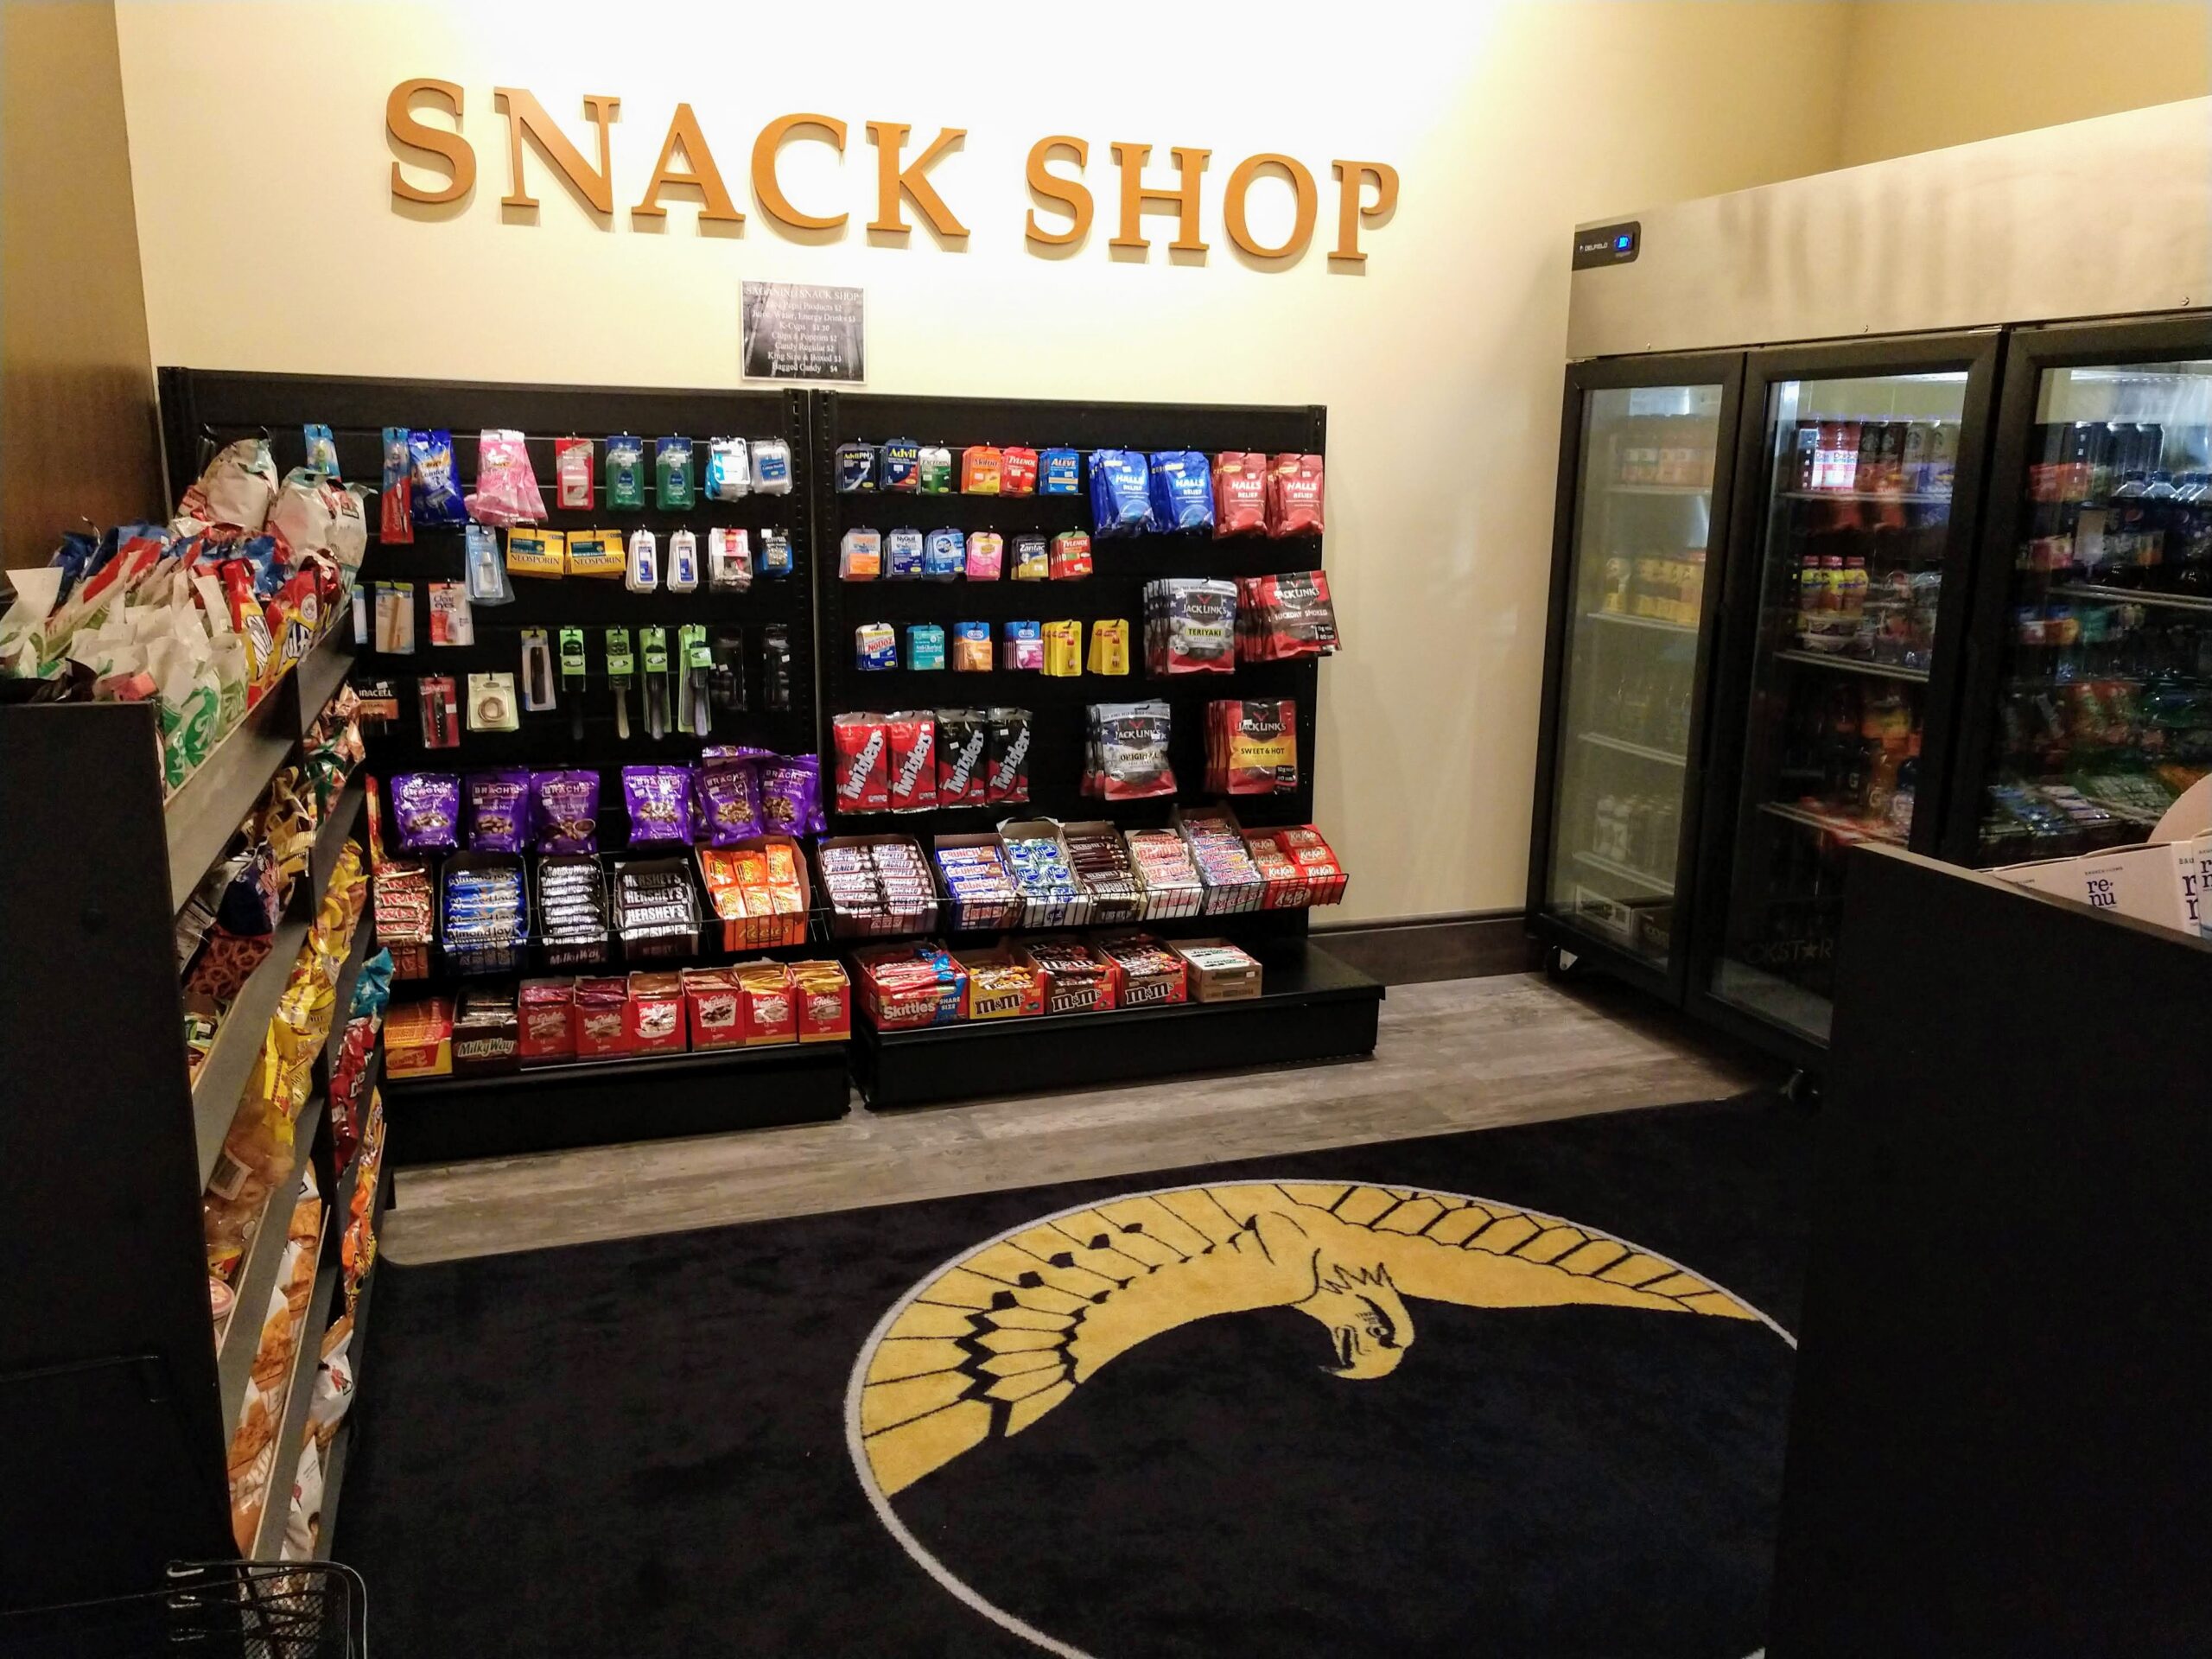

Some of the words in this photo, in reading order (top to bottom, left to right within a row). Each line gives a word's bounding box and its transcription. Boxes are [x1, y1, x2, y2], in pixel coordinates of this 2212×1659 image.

[385, 78, 971, 238] SNACK
[1026, 135, 1400, 263] SHOP
[799, 289, 832, 300] SNACK
[834, 291, 860, 301] SHOP
[804, 302, 833, 311] Products
[798, 312, 822, 322] Energy
[823, 314, 848, 322] Drinks
[779, 321, 806, 332] K-Cups
[772, 331, 792, 340] Chips
[800, 333, 829, 342] Popcorn
[775, 341, 798, 351] Candy
[798, 343, 825, 352] Regular
[767, 352, 785, 361] King
[786, 353, 801, 361] Size
[810, 353, 832, 362] Boxed
[772, 361, 798, 372] Bagged
[799, 363, 822, 373] Candy
[830, 365, 838, 373] $4
[889, 448, 917, 458] Advil
[1008, 456, 1036, 466] TYLENOL
[1051, 458, 1077, 467] ALEVE
[1115, 474, 1145, 485] HALLS
[1175, 479, 1205, 487] HALLS
[1231, 480, 1262, 490] HALLS
[1287, 482, 1317, 491] HALLS
[1020, 543, 1046, 553] Zantac
[511, 554, 560, 565] NEOSPORIN
[574, 556, 622, 566] NEOSPORIN
[434, 594, 454, 603] Clear
[1273, 589, 1295, 600] JACK
[1181, 604, 1203, 614] JACK
[1236, 722, 1260, 732] JACK
[1114, 730, 1135, 741] JACK
[940, 849, 978, 860] CRUNCH
[949, 866, 987, 876] CRUNCH
[957, 880, 996, 891] CRUNCH
[626, 887, 684, 904] HERSHEY'S
[2089, 892, 2116, 907] nu
[626, 904, 686, 922] HERSHEY'S
[447, 927, 490, 941] Almond
[939, 996, 961, 1005] SHARE
[883, 1001, 936, 1020] Skittles
[457, 1040, 491, 1058] Milky
[489, 1038, 515, 1054] Way
